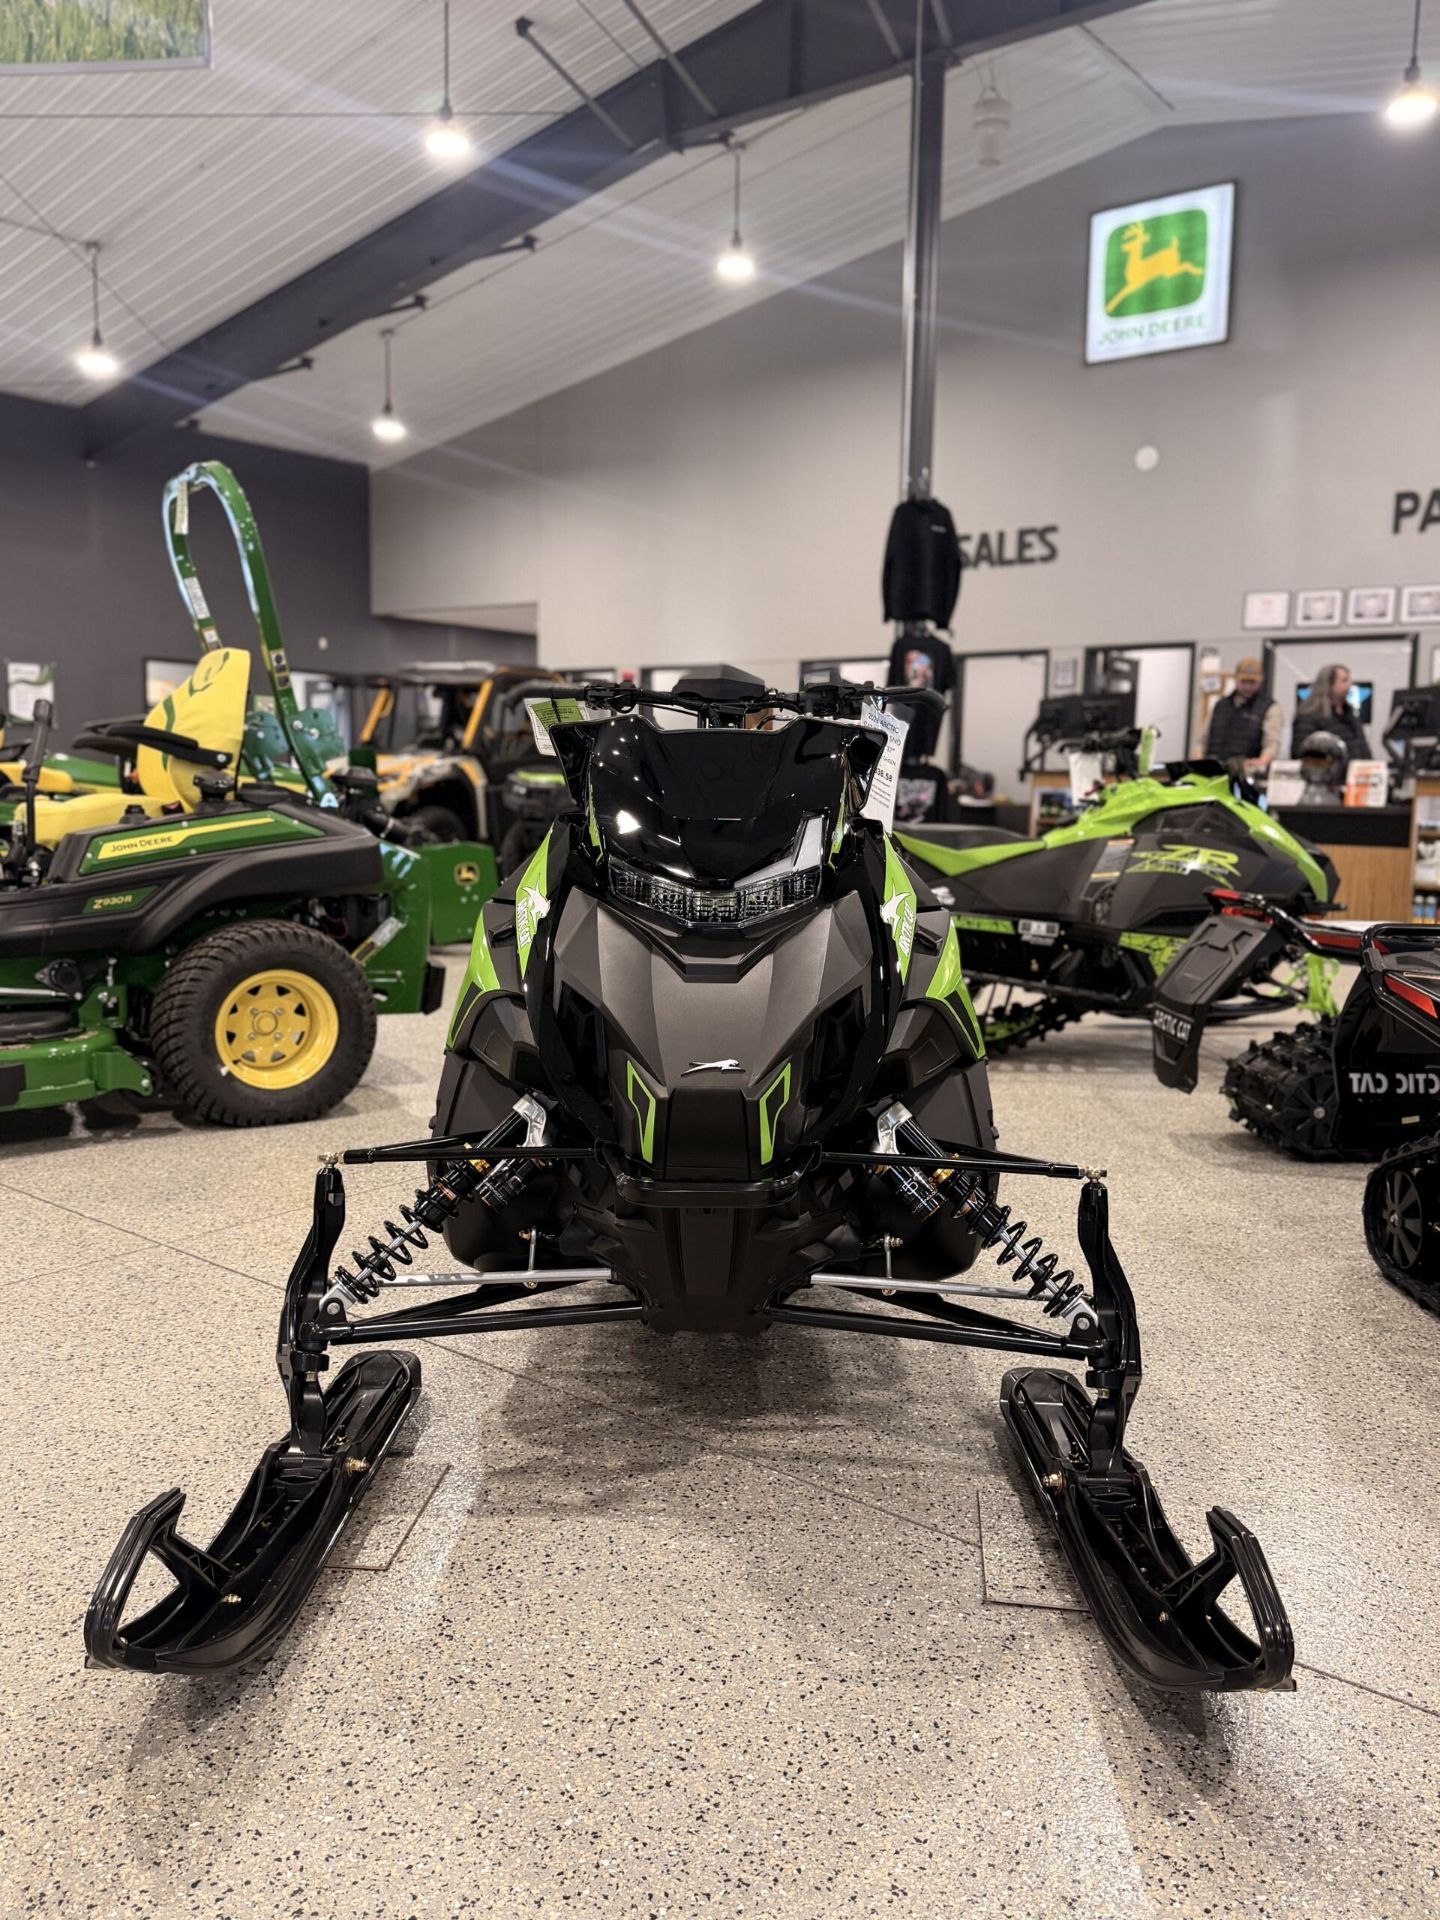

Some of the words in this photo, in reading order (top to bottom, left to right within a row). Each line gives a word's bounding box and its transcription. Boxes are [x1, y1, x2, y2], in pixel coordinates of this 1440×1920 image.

[1098, 327, 1144, 345] JOHN
[1148, 314, 1206, 337] DEERE
[112, 843, 137, 853] JOHN
[139, 836, 173, 847] DEERE
[92, 895, 133, 909] Z930R
